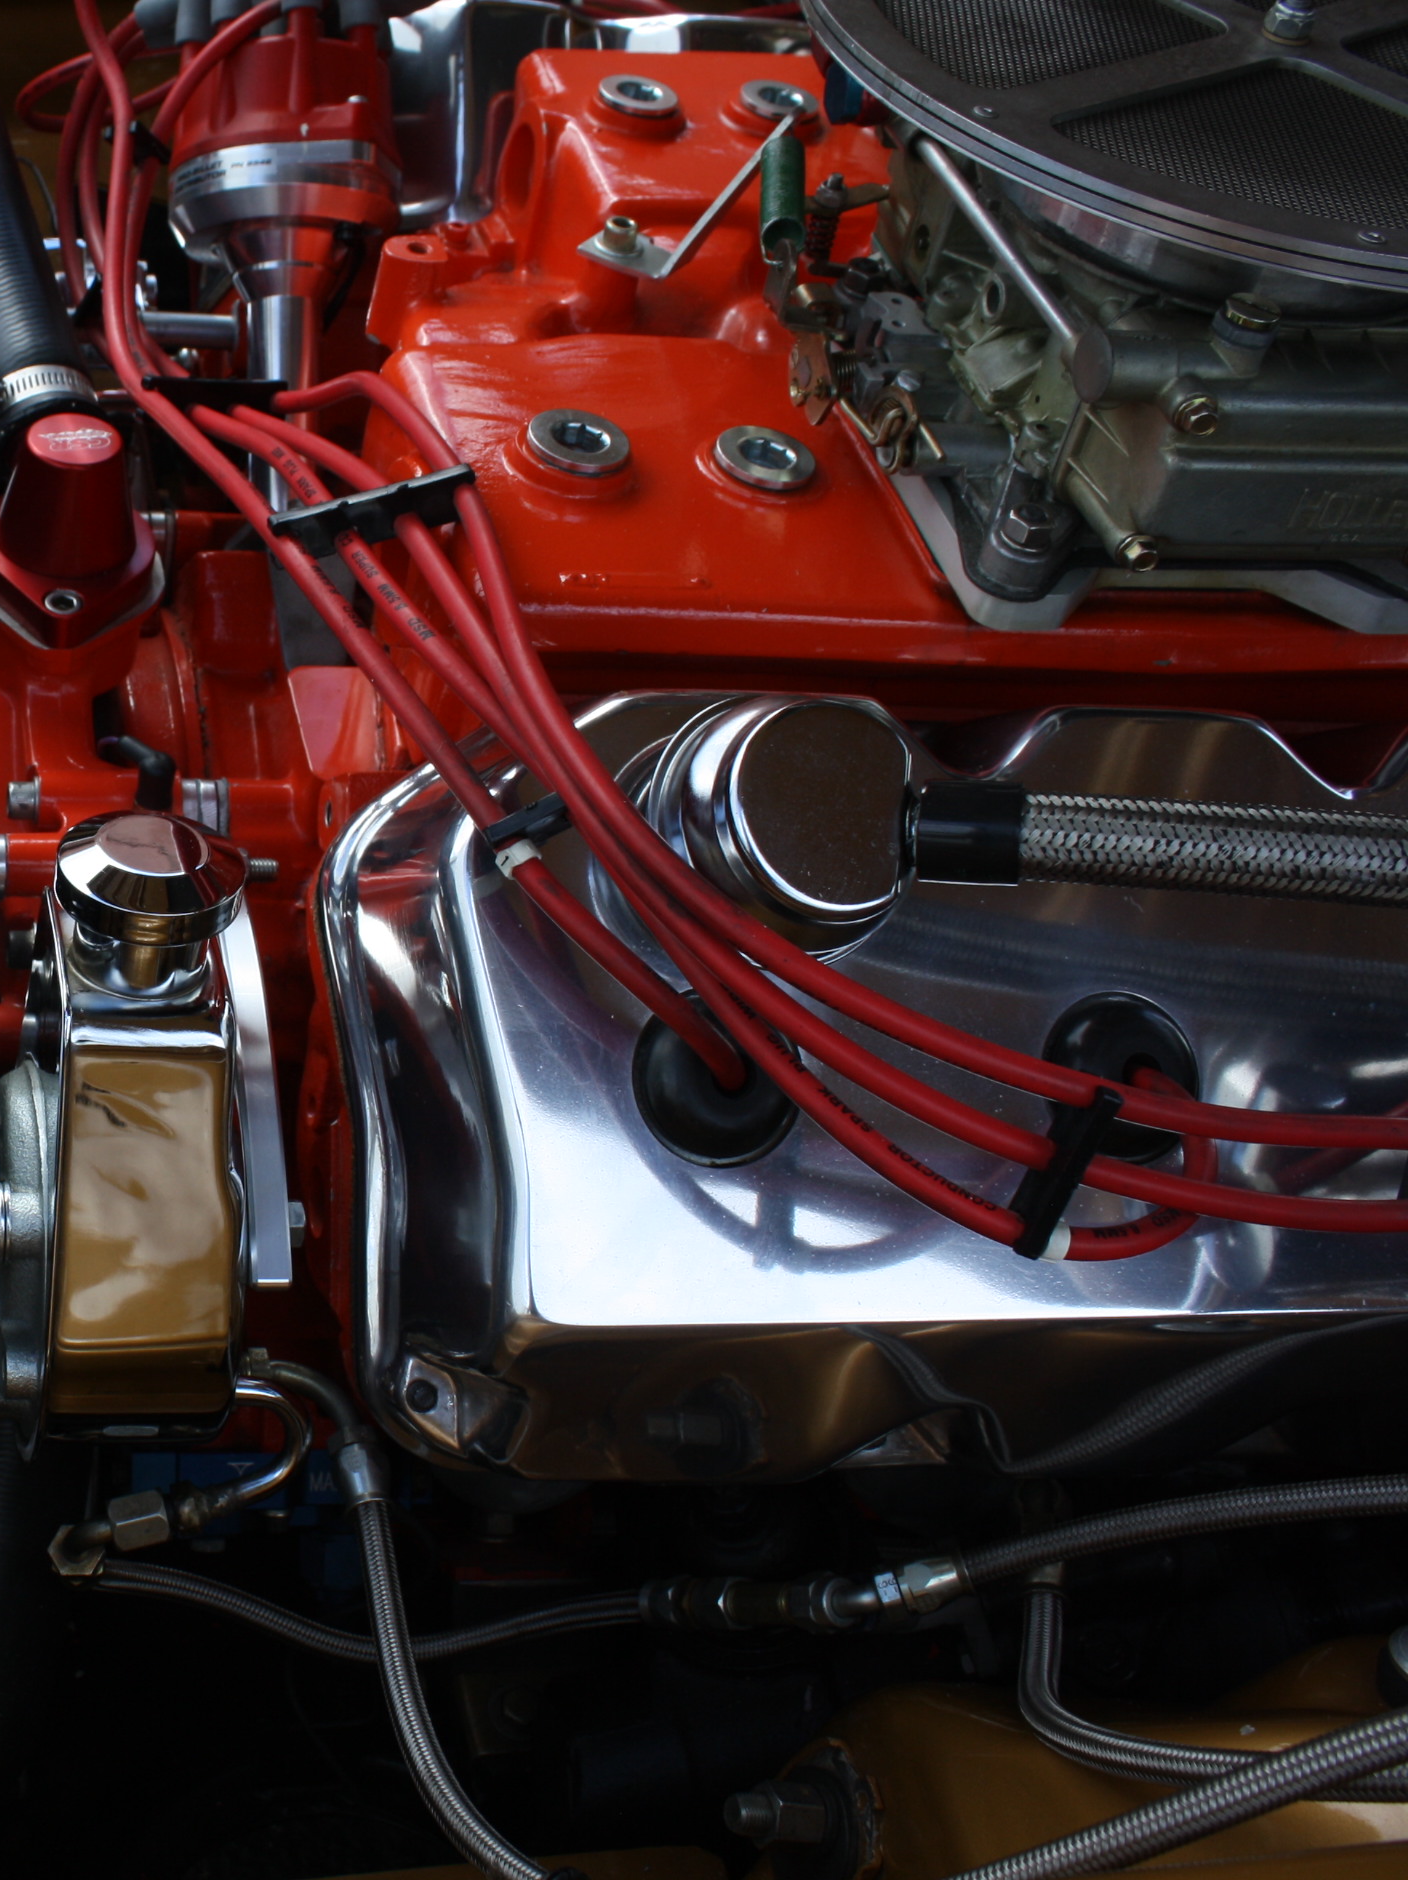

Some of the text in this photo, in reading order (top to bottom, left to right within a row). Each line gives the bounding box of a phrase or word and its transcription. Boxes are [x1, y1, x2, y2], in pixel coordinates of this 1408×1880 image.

[351, 550, 379, 579] SUPER
[407, 616, 437, 641] MSD
[766, 1032, 807, 1074] PLUG
[818, 1086, 873, 1133] SPARK
[887, 1142, 998, 1212] CONDUCTOR
